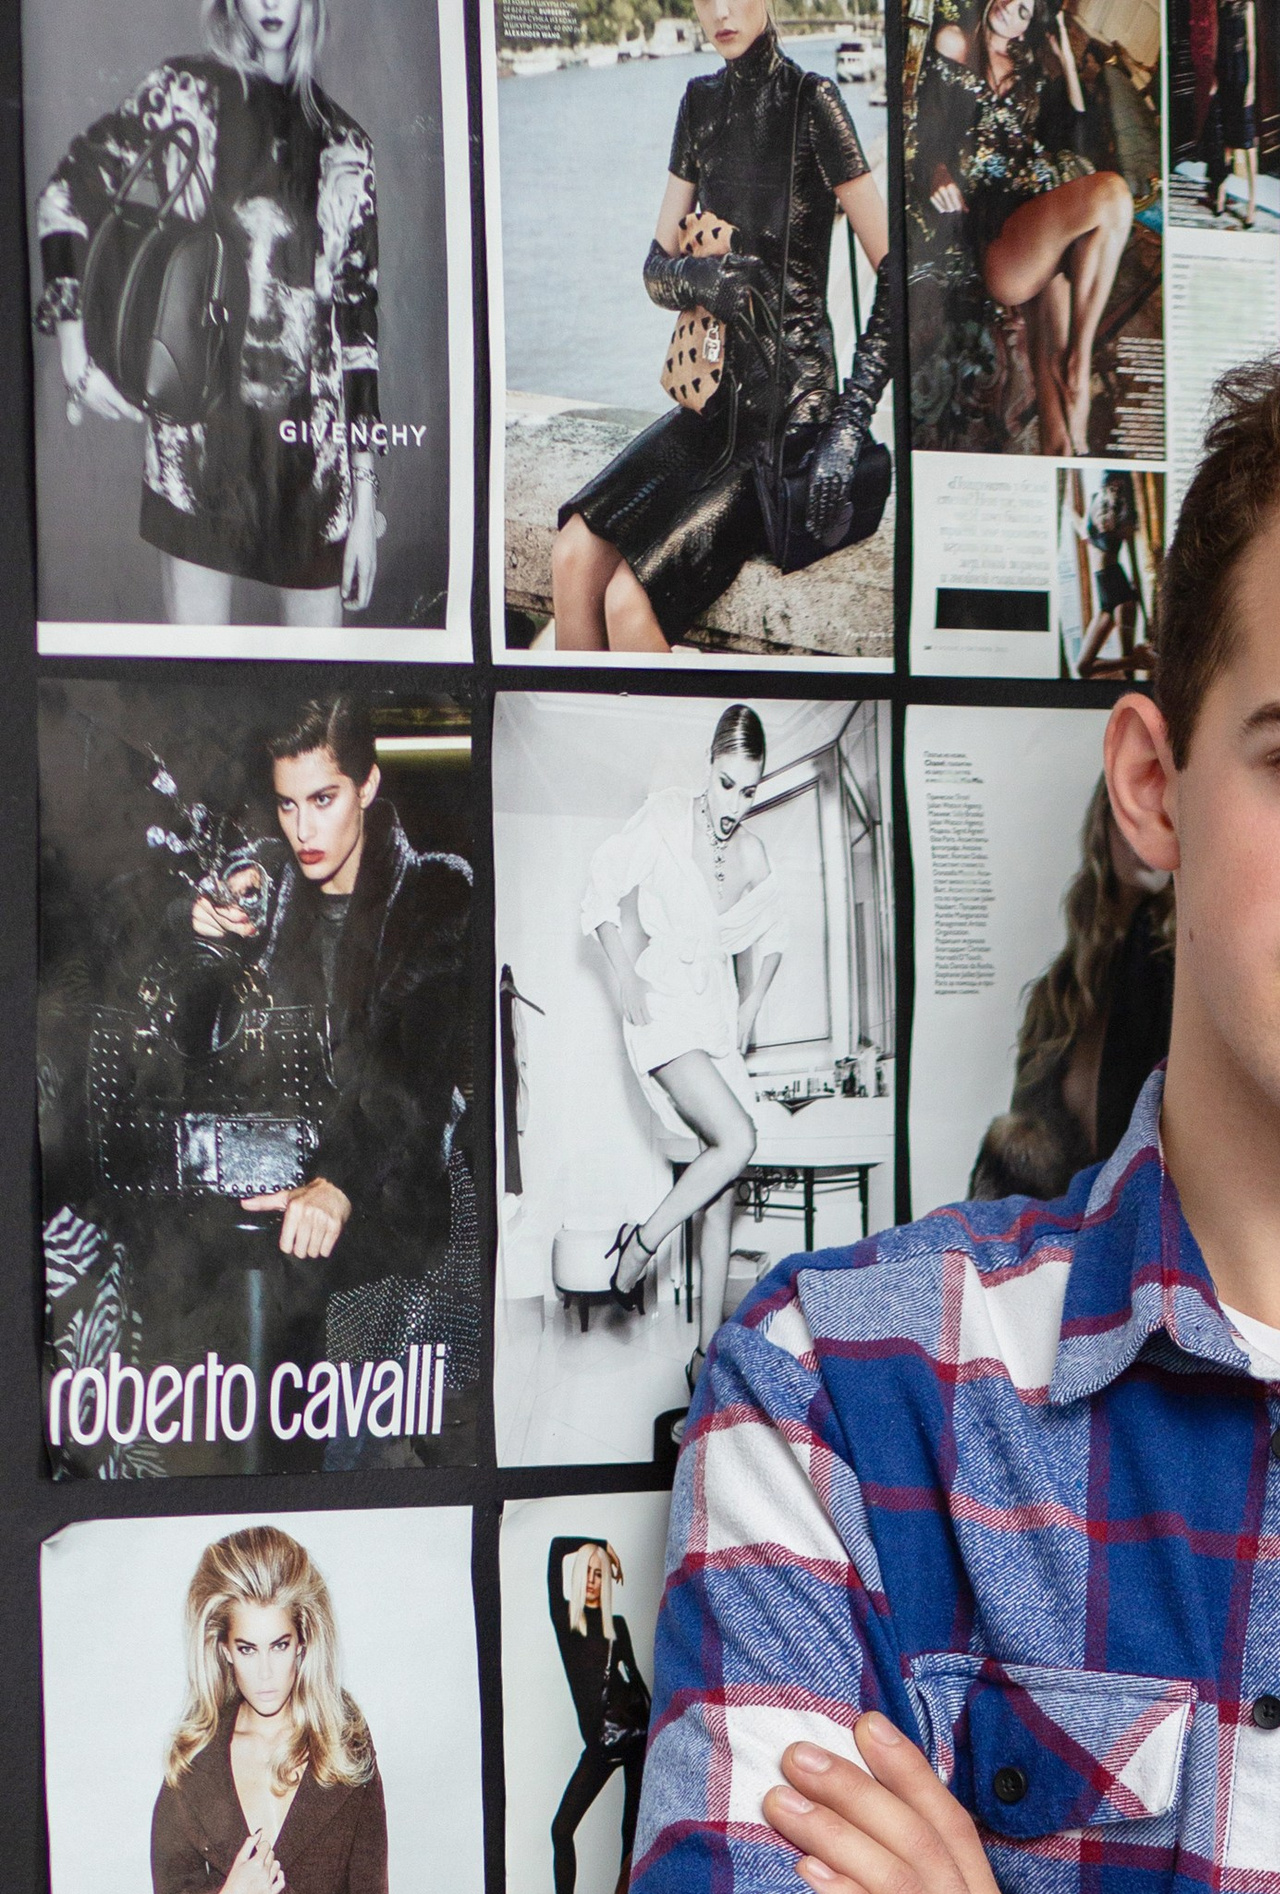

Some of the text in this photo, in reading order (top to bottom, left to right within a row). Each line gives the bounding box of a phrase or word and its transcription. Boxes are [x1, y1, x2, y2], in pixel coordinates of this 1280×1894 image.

[504, 29, 540, 38] ALEXANDER
[278, 419, 427, 447] GIVENCHY
[48, 1343, 446, 1446] roberto cavalli
